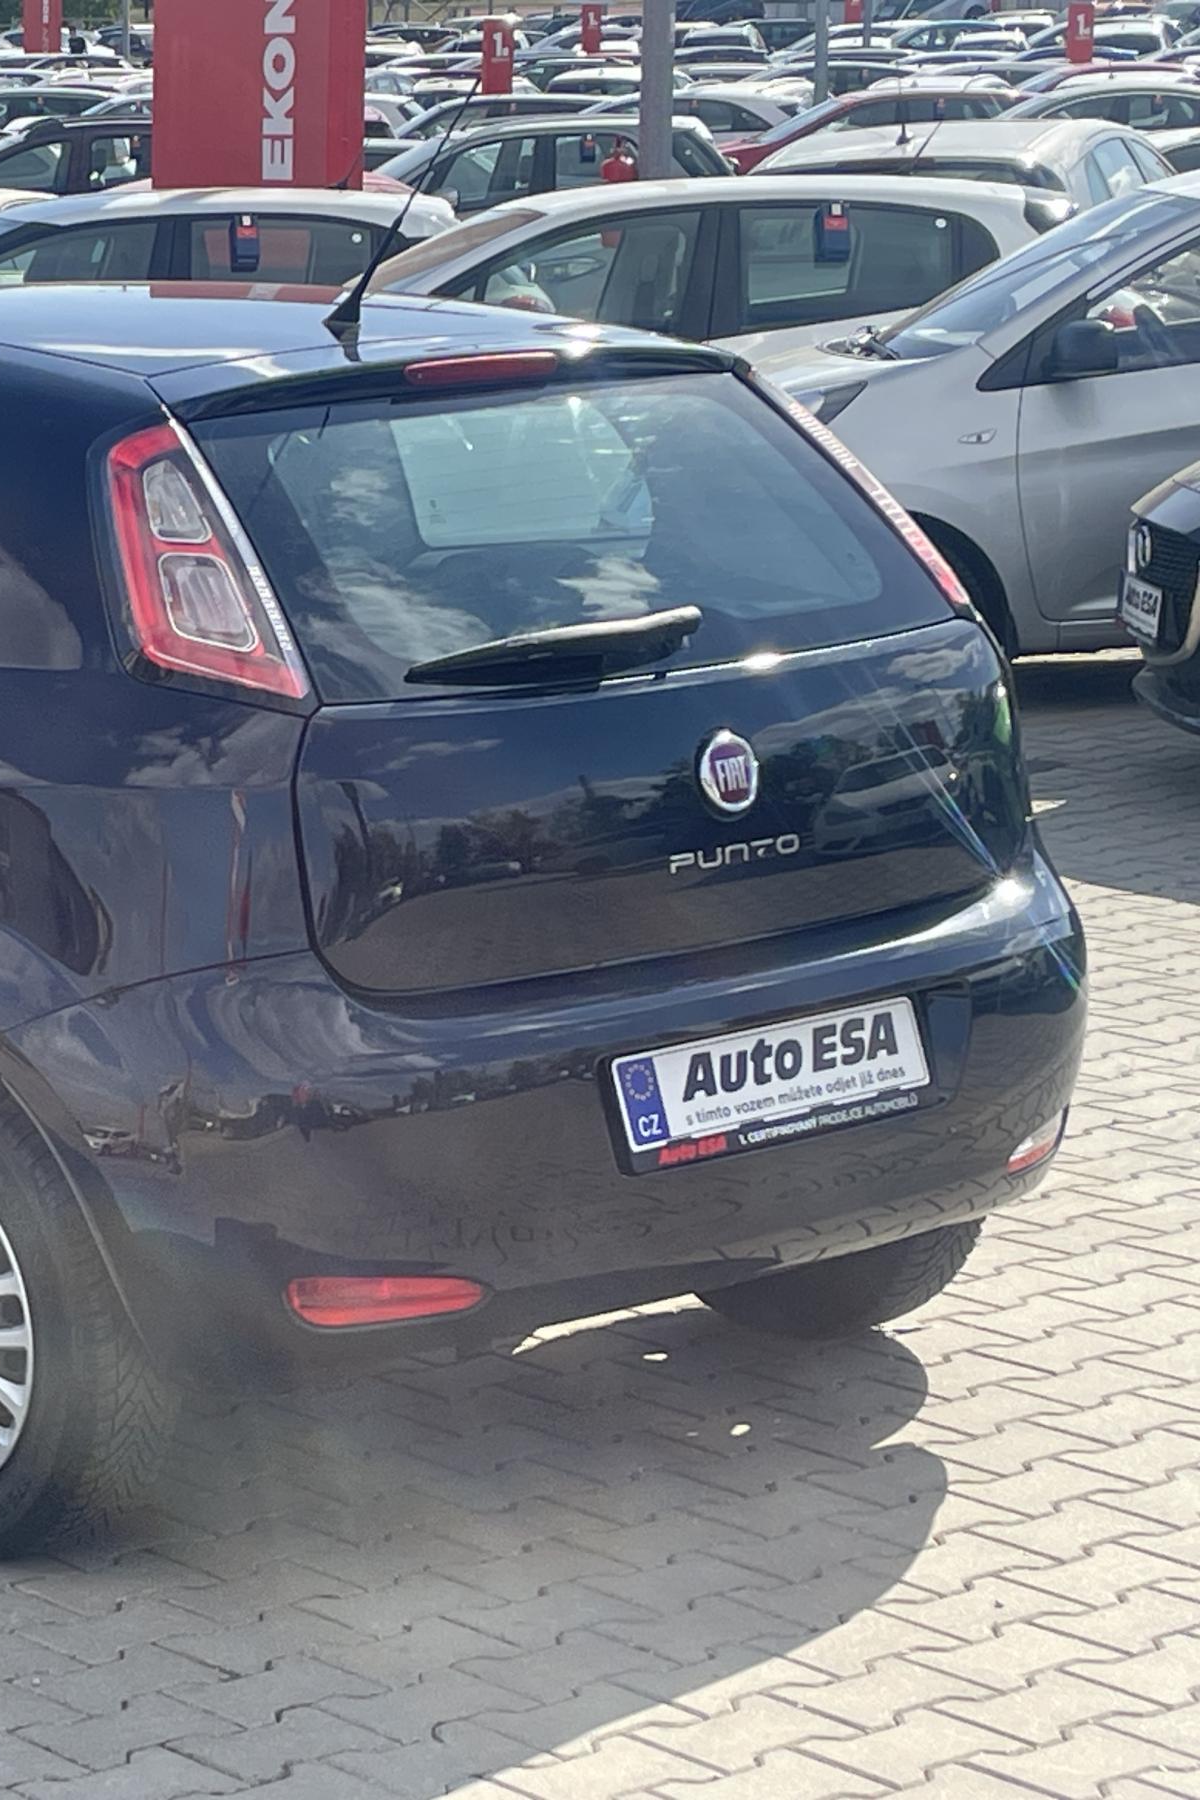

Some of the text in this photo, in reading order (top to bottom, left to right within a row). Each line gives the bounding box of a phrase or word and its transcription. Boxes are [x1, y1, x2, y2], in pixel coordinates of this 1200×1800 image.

[715, 755, 748, 792] FIAT
[669, 833, 800, 874] PUNTO
[682, 1012, 899, 1103] Auto ESA
[733, 1097, 776, 1114] vozem
[824, 1074, 859, 1094] odjet
[876, 1066, 906, 1083] dnes
[638, 1113, 662, 1138] CZ
